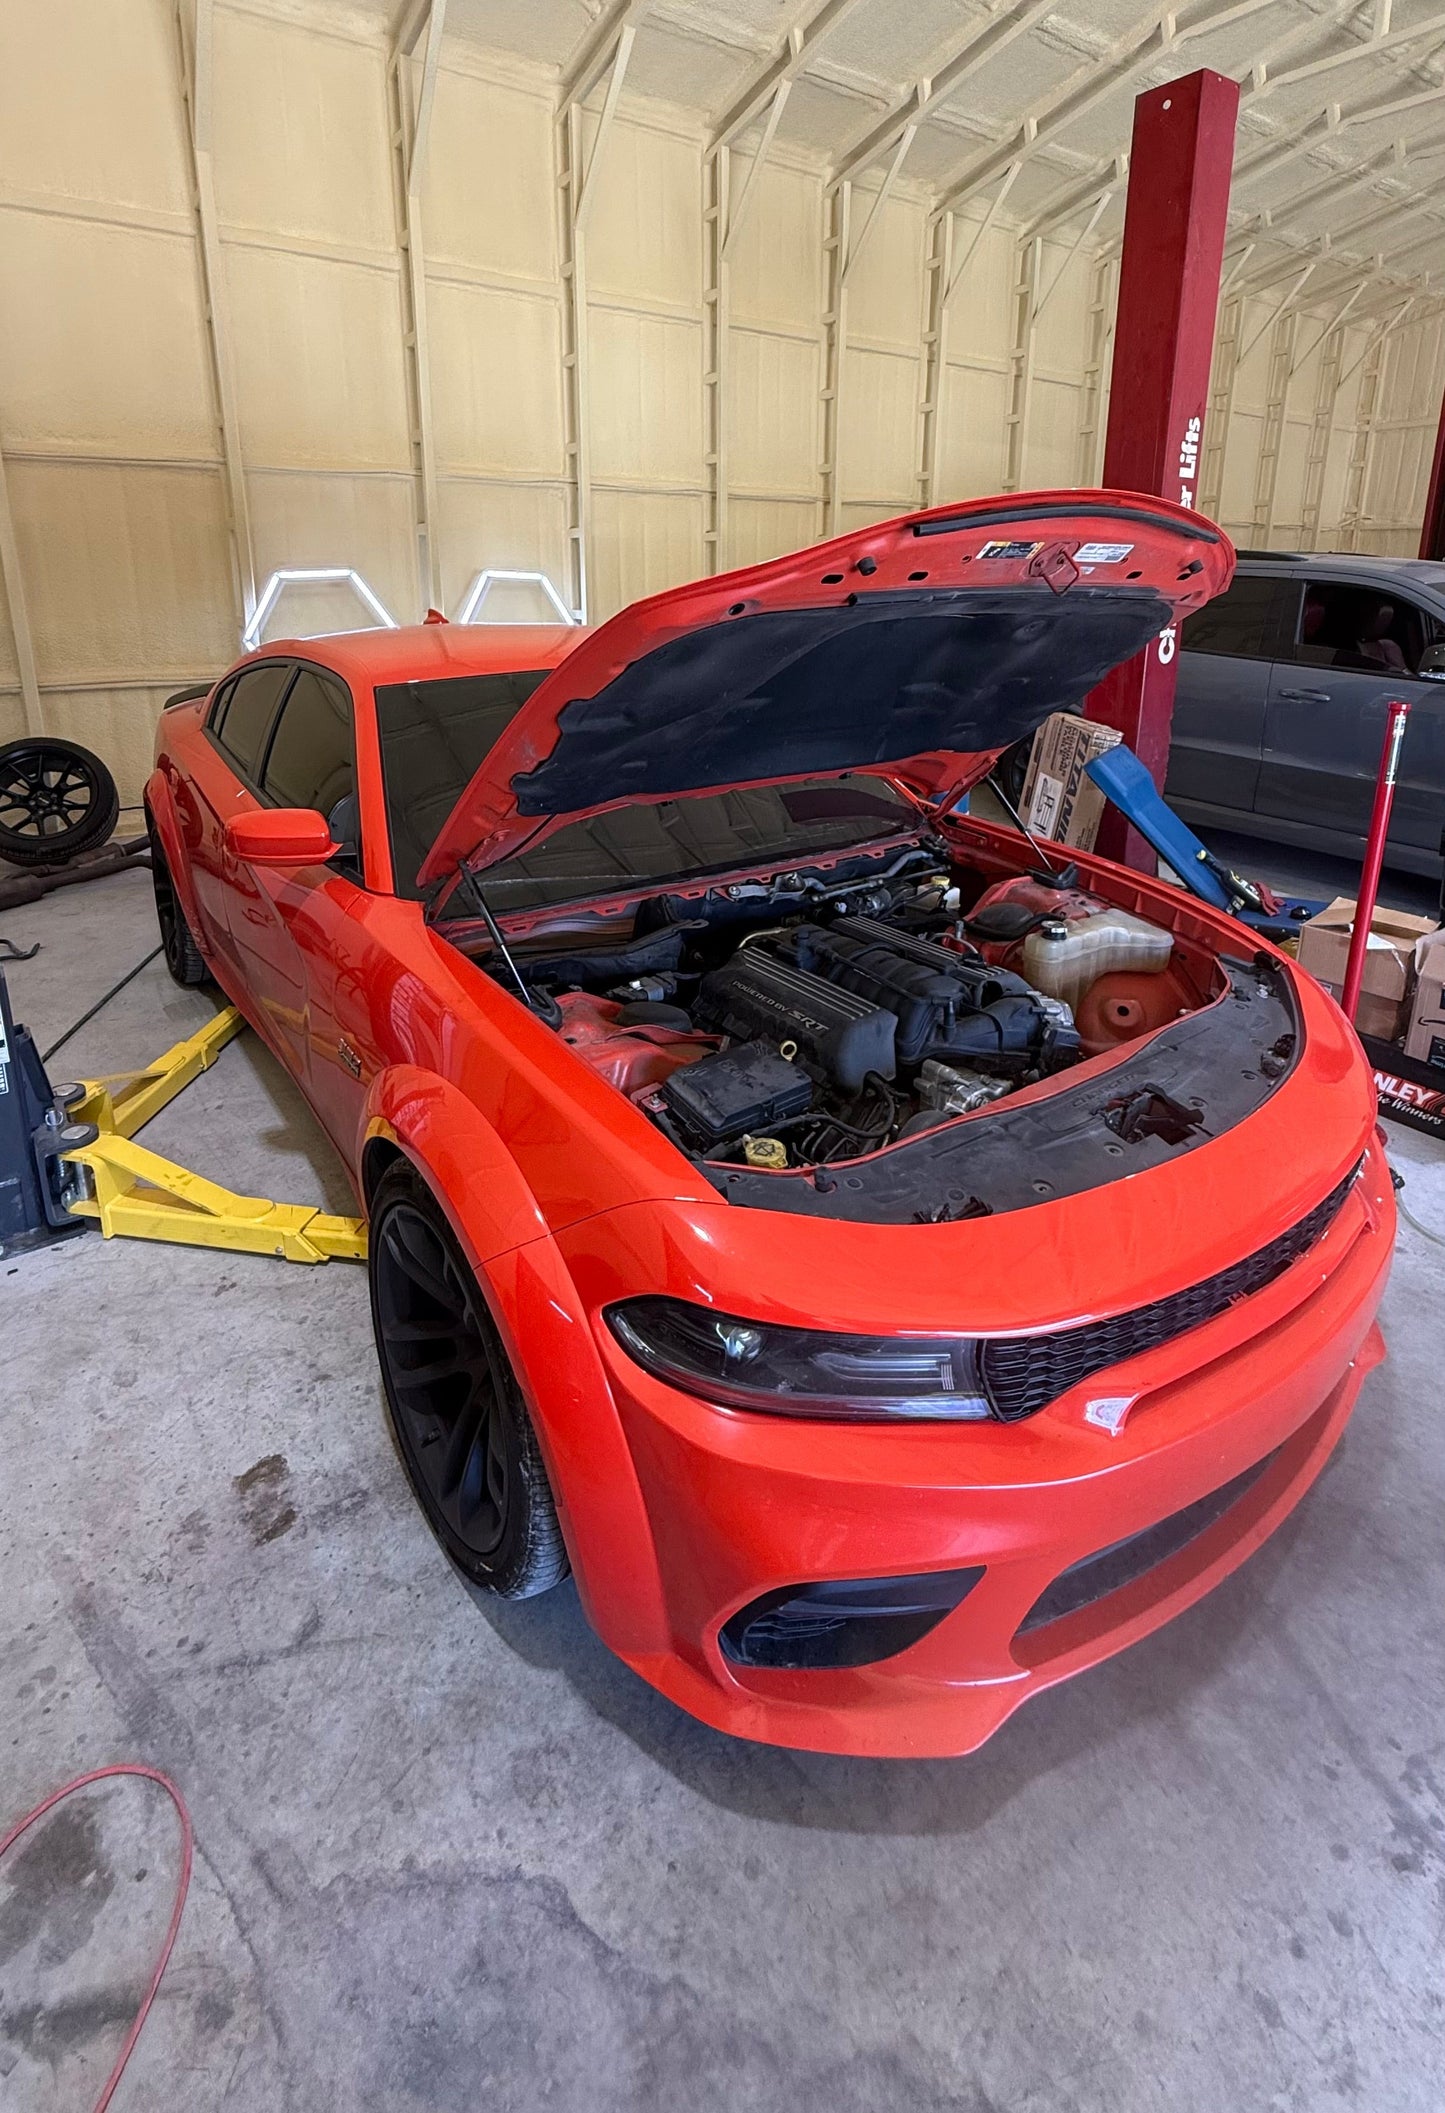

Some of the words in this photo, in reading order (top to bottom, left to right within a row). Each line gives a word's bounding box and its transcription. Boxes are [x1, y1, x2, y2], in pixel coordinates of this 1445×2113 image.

[1179, 416, 1201, 478] Lifts
[732, 980, 776, 1006] POWERED
[774, 1003, 790, 1012] BY
[788, 1010, 830, 1032] SRT
[1374, 1072, 1436, 1106] NLEY
[1391, 1097, 1444, 1125] Winners
